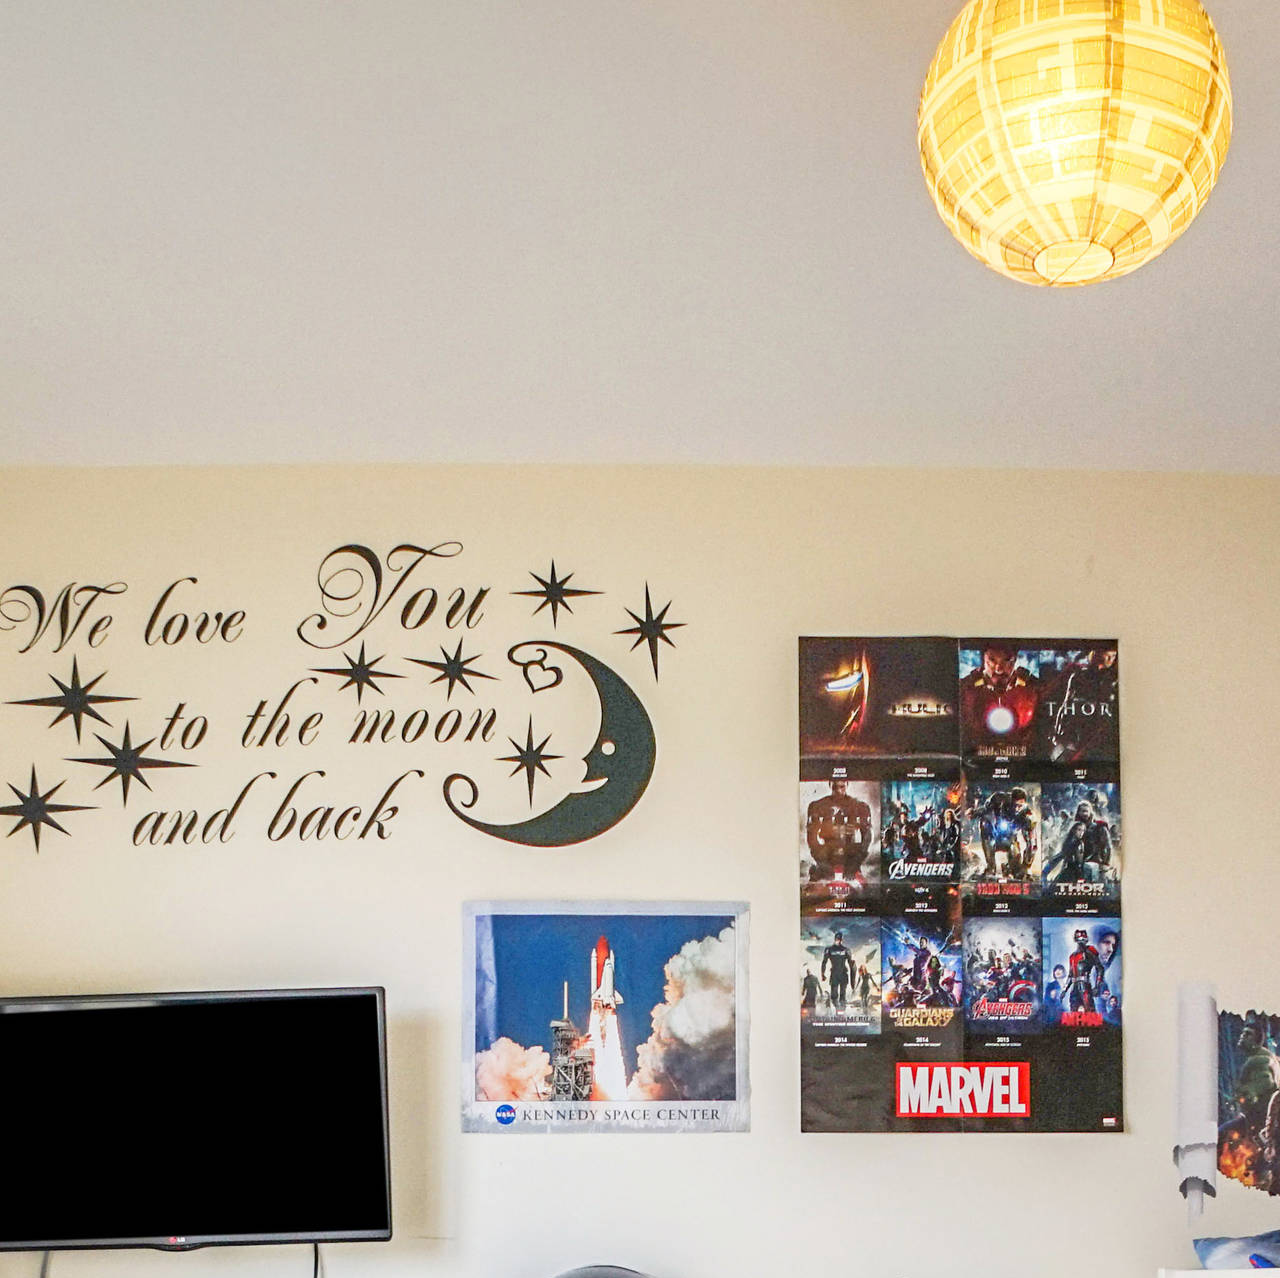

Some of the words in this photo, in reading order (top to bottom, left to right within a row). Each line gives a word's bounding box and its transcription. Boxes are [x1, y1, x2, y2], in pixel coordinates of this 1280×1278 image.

[144, 577, 247, 645] love
[296, 541, 491, 650] You
[160, 701, 208, 751] to
[241, 677, 322, 746] the
[348, 705, 499, 746] moon
[1046, 701, 1113, 717] THOR
[132, 771, 277, 847] and
[268, 769, 424, 842] back
[1056, 882, 1106, 893] THOR
[899, 1066, 1026, 1113] MARVEL
[523, 1109, 598, 1121] KENNEDY
[604, 1109, 651, 1121] SPACE
[657, 1109, 720, 1121] CENTER
